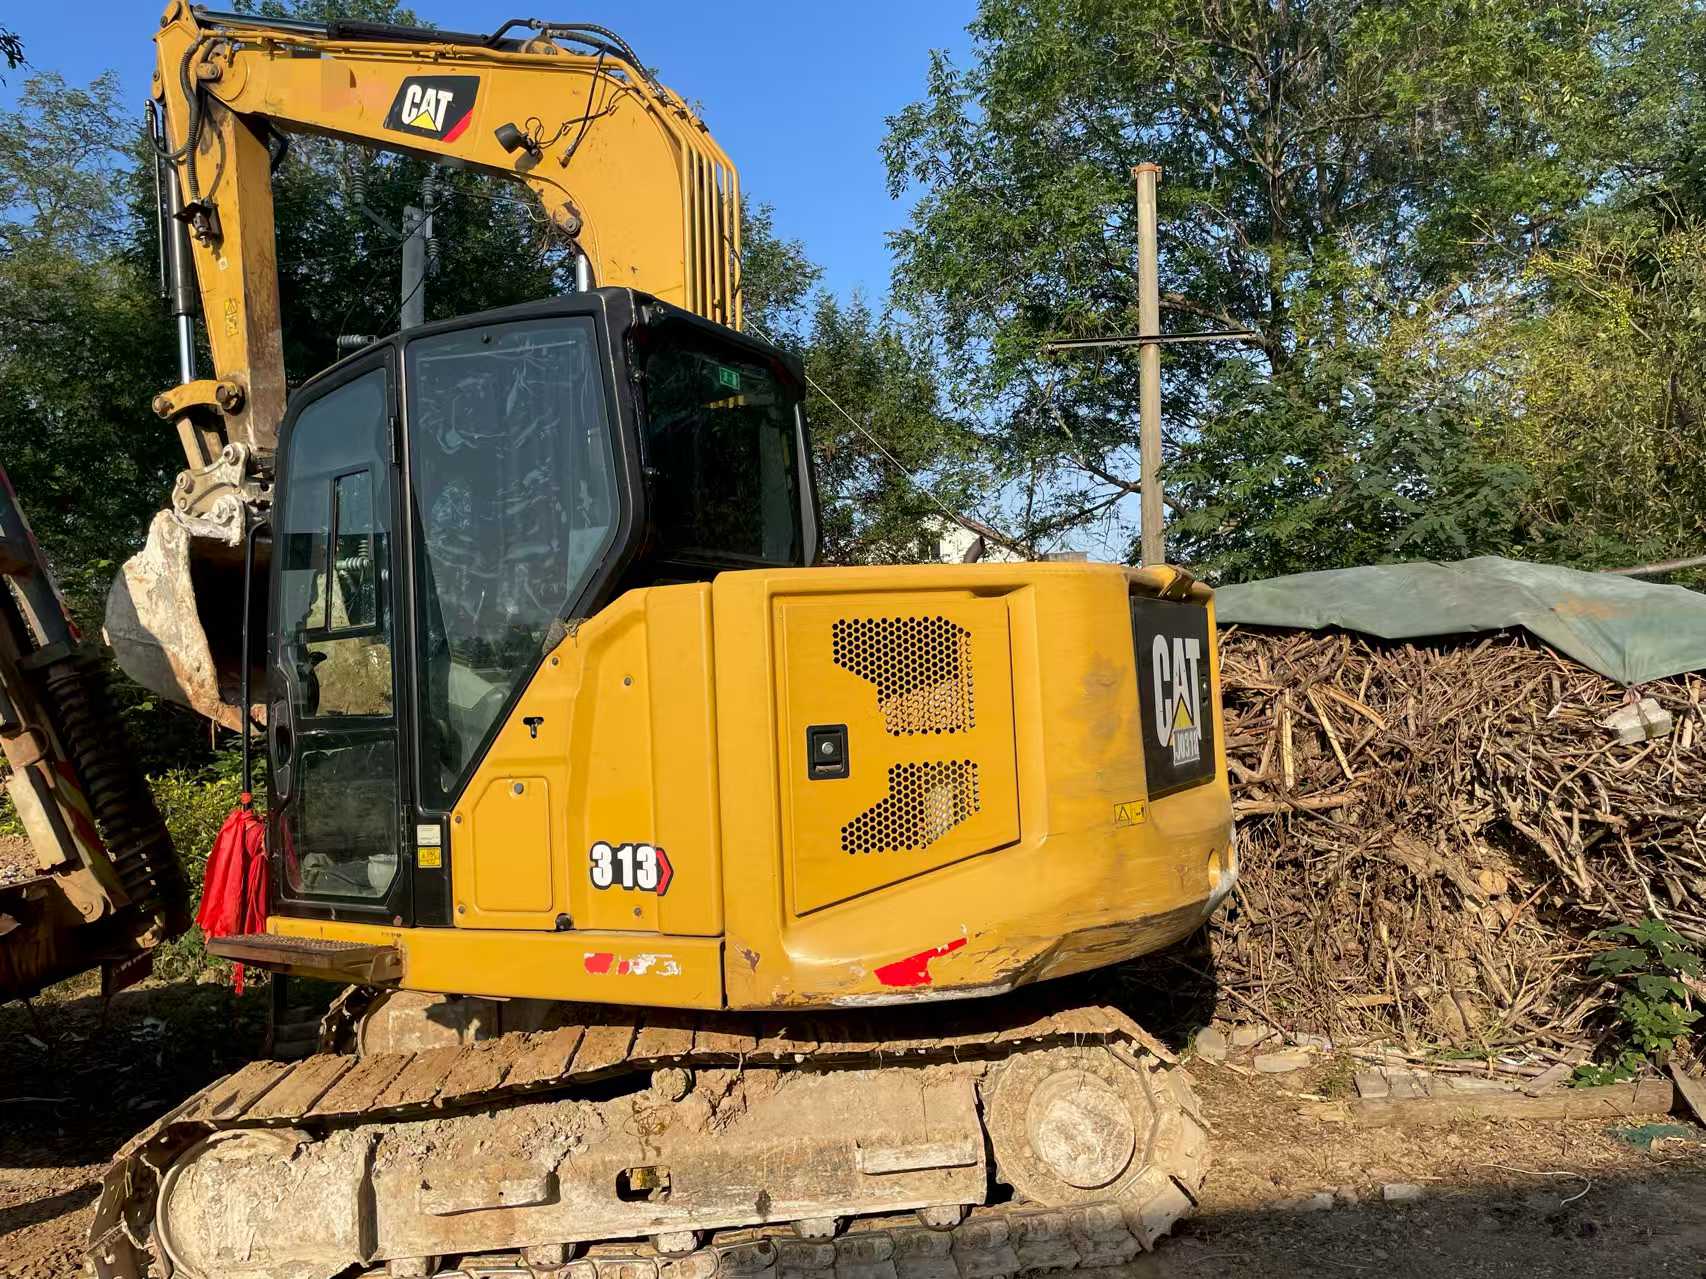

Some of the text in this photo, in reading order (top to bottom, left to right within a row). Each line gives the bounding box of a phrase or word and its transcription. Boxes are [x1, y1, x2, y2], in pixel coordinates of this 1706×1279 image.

[402, 84, 454, 132] CAT
[1152, 633, 1202, 747] CAT
[591, 842, 658, 890] 313
